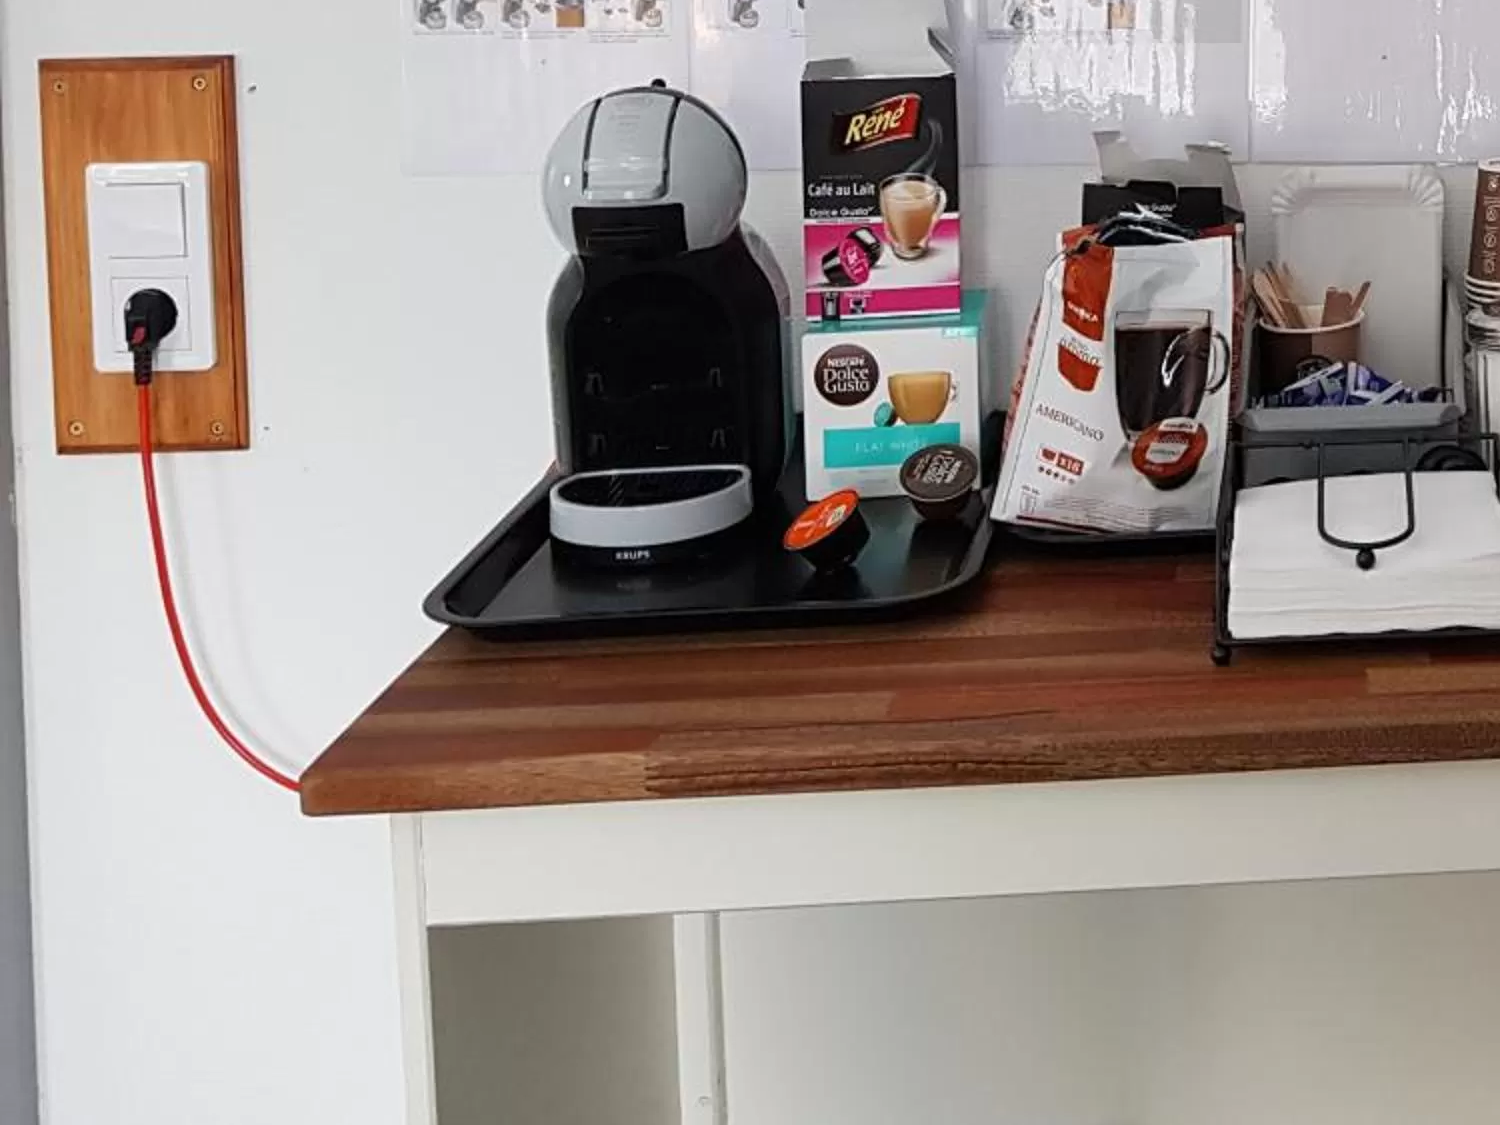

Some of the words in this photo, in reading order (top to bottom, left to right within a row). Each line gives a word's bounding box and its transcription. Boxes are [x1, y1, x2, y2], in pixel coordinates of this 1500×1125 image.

[844, 97, 907, 146] René
[808, 181, 834, 196] Café
[835, 186, 851, 196] au
[853, 181, 875, 196] Lait
[823, 367, 870, 383] Dolce
[824, 378, 871, 394] Gusto
[615, 549, 651, 560] KRUPS
